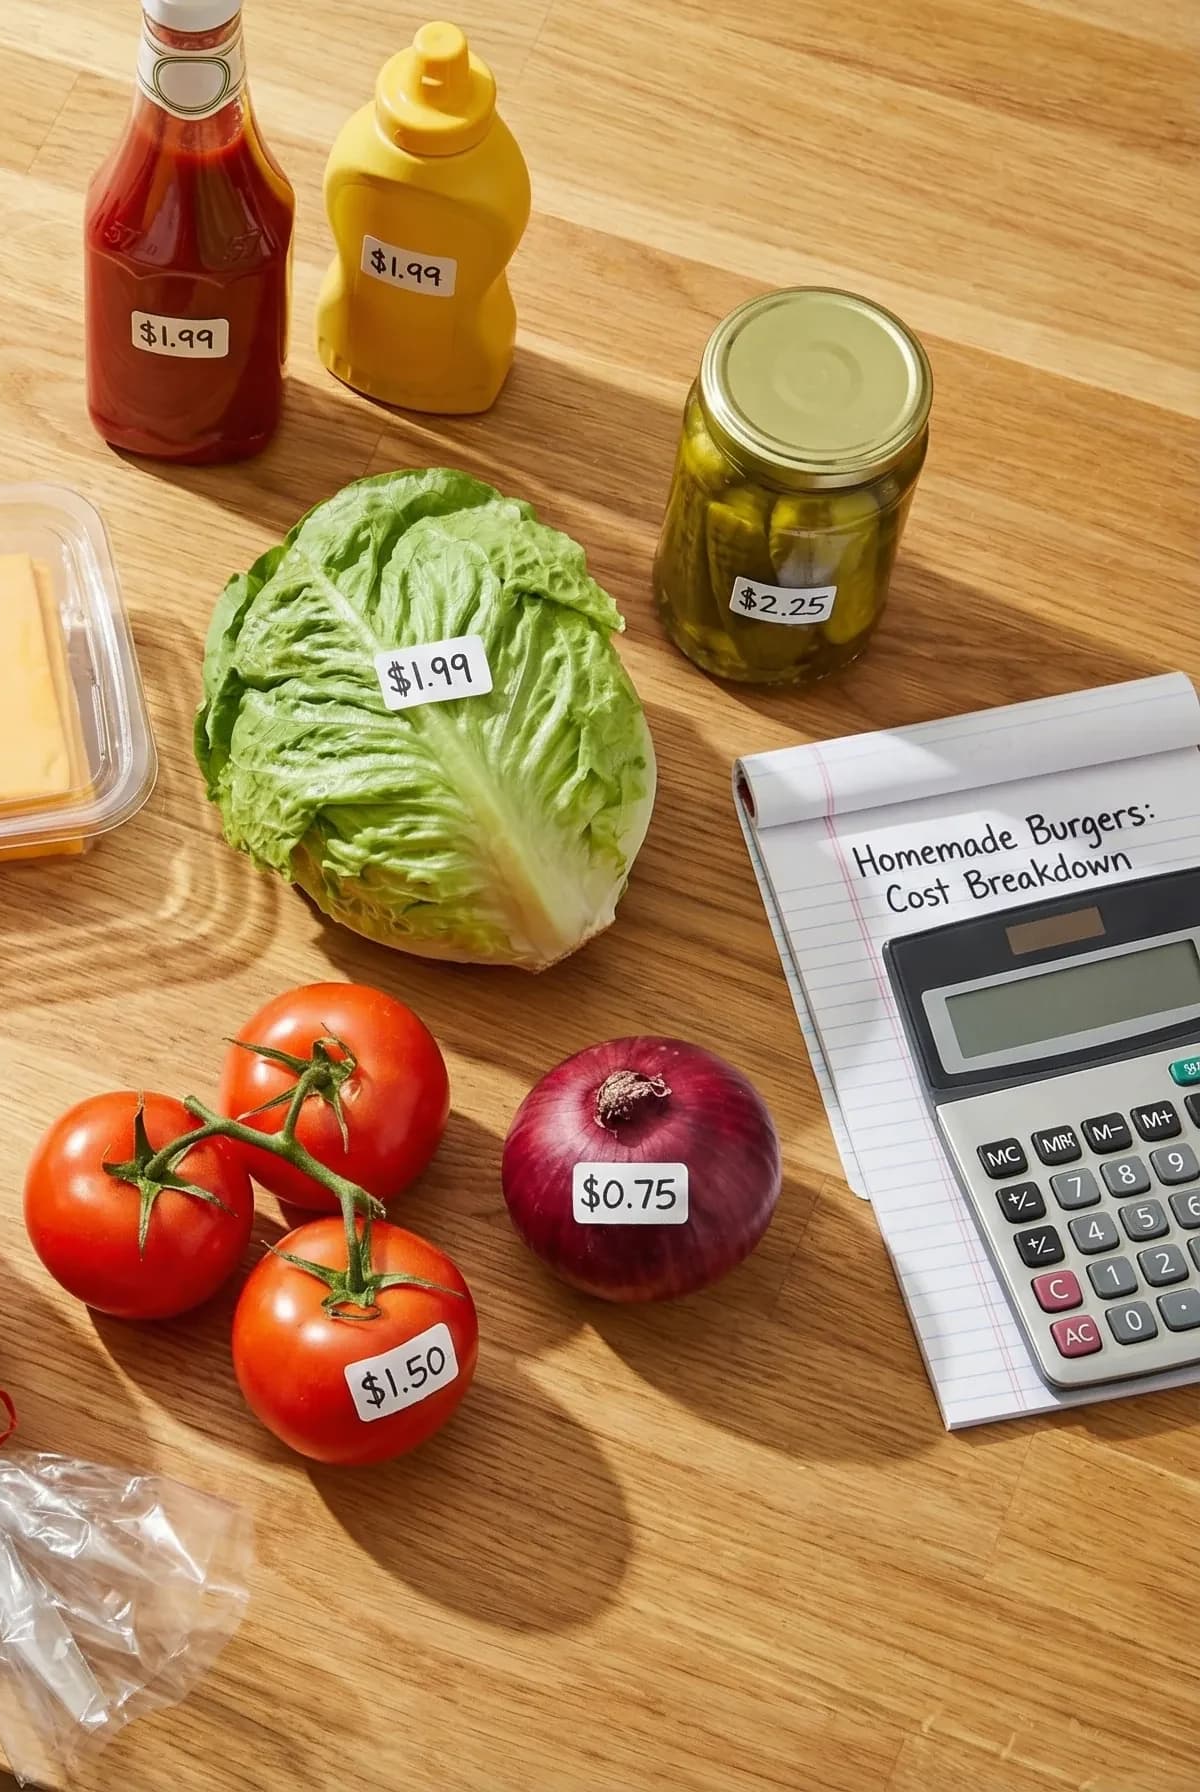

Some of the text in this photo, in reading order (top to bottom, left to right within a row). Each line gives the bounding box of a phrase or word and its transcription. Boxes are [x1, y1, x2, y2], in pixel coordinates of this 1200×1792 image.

[371, 248, 441, 287] $1.99
[140, 319, 214, 350] $1.99
[738, 586, 830, 617] $2.25
[387, 653, 473, 697] $1.99
[853, 804, 1155, 877] Homemade Burgers:
[886, 852, 1133, 913] Cost Breakdown
[986, 1145, 1021, 1168] MC
[1141, 1109, 1174, 1130] M+
[580, 1174, 677, 1213] $0.75
[1067, 1176, 1083, 1199] 7
[1119, 1164, 1136, 1185] 8
[1167, 1152, 1185, 1173] 9
[1088, 1221, 1105, 1241] 4
[1137, 1207, 1155, 1228] 5
[1187, 1195, 1200, 1216] 6
[1049, 1252, 1176, 1300] C 1 2
[1065, 1323, 1095, 1347] AC
[1125, 1310, 1143, 1331] 0
[361, 1345, 446, 1409] $1.50
